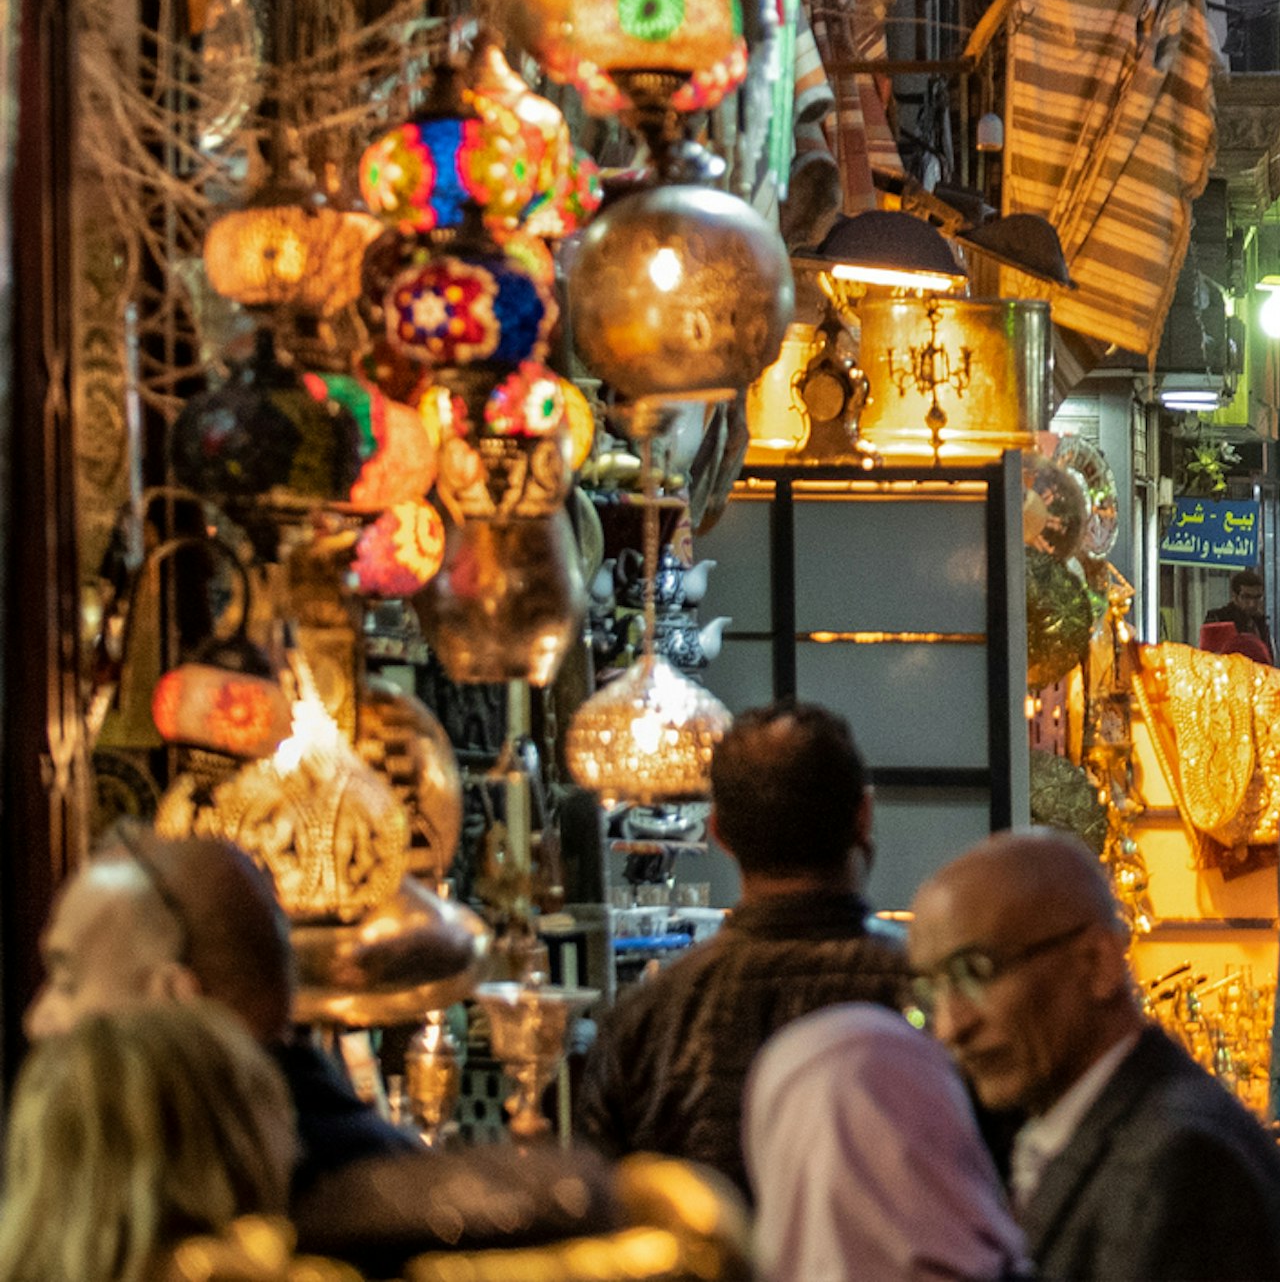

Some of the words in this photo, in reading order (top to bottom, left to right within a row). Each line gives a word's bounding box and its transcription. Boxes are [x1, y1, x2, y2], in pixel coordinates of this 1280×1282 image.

[1171, 502, 1205, 527] شرا
[1223, 509, 1255, 533] بيع
[1212, 535, 1254, 559] الذهب
